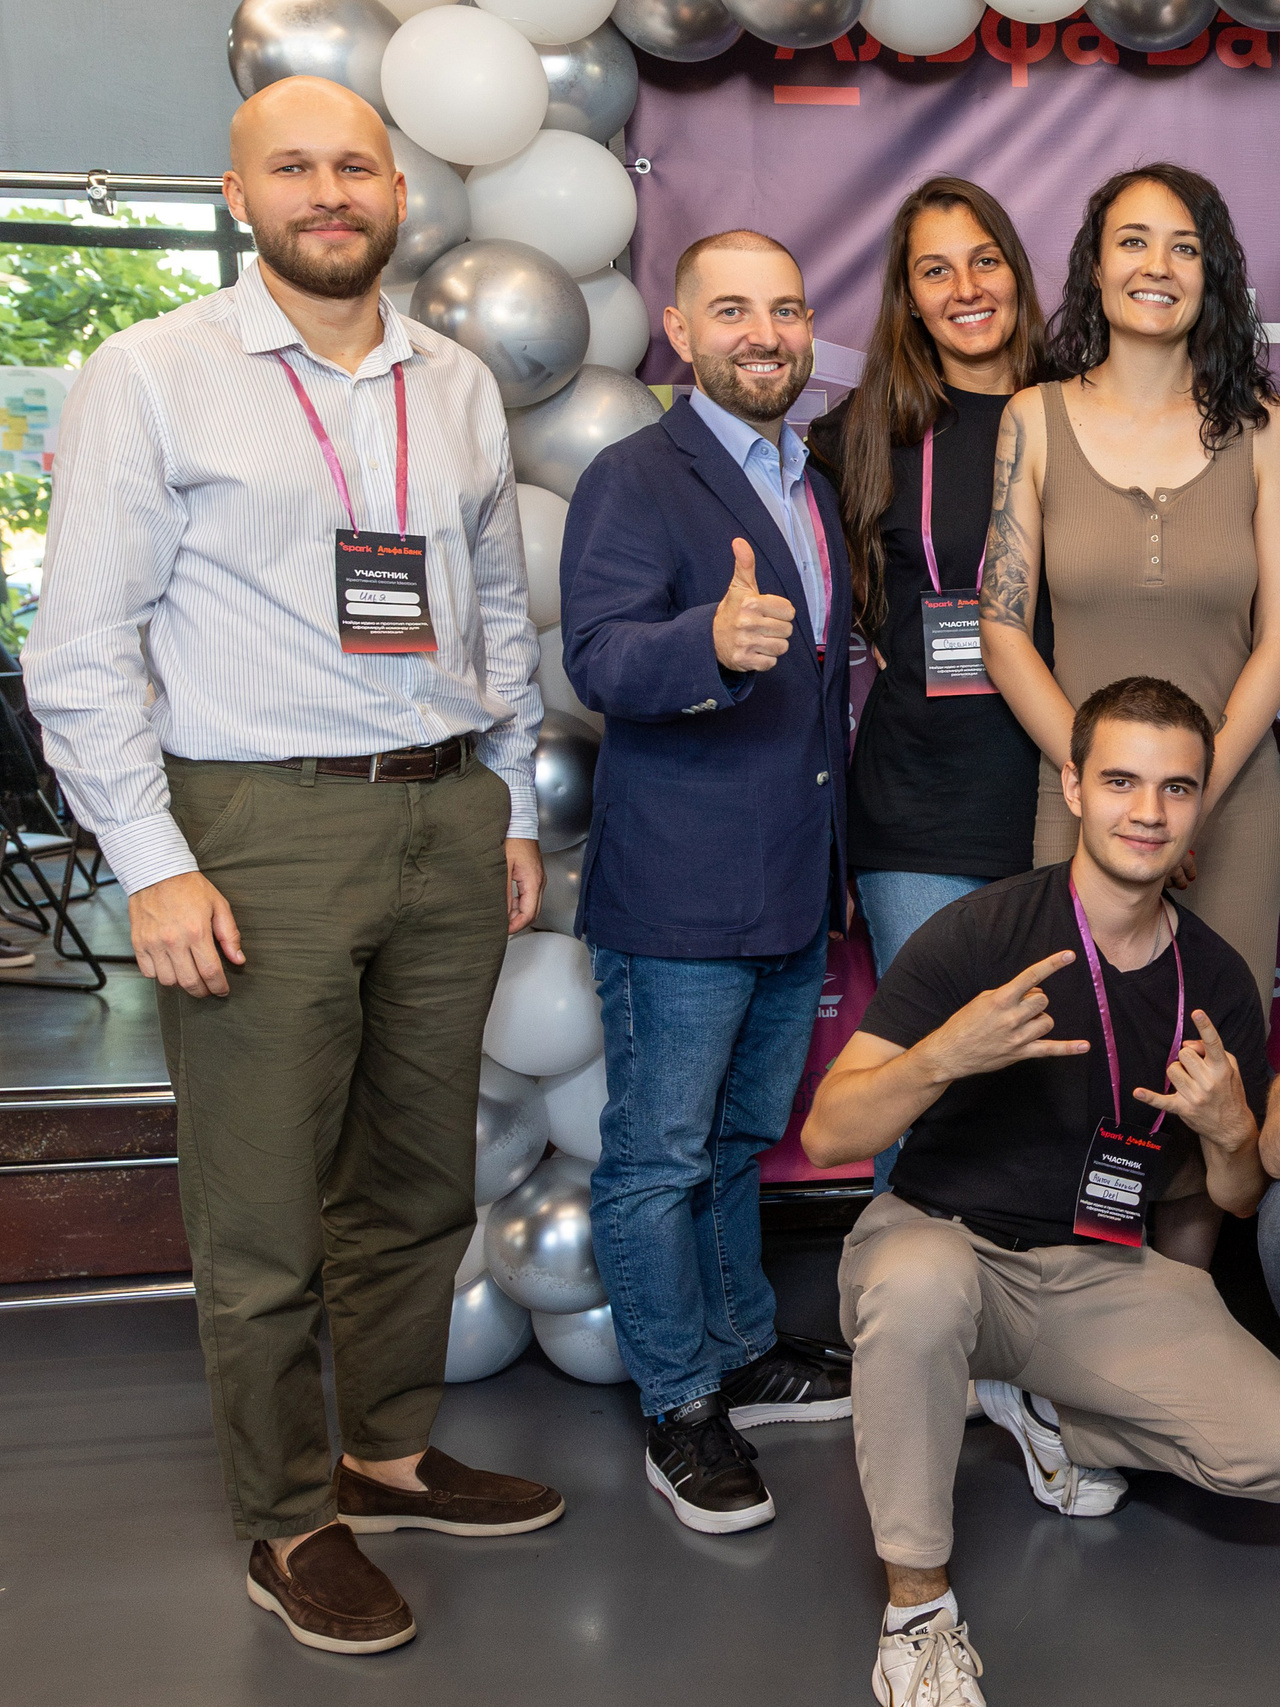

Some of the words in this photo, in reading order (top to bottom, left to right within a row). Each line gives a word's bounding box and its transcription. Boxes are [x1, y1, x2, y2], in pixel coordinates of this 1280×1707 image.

[342, 544, 373, 553] spark
[377, 545, 403, 556] Альфа
[403, 547, 423, 556] Банк
[354, 569, 409, 580] УЧАСТНИК
[938, 620, 979, 629] УЧАСТНИ
[816, 1006, 838, 1018] lub
[1101, 1129, 1123, 1141] spark
[1102, 1153, 1142, 1170] УЧАСТНИК
[673, 1398, 708, 1422] adidas
